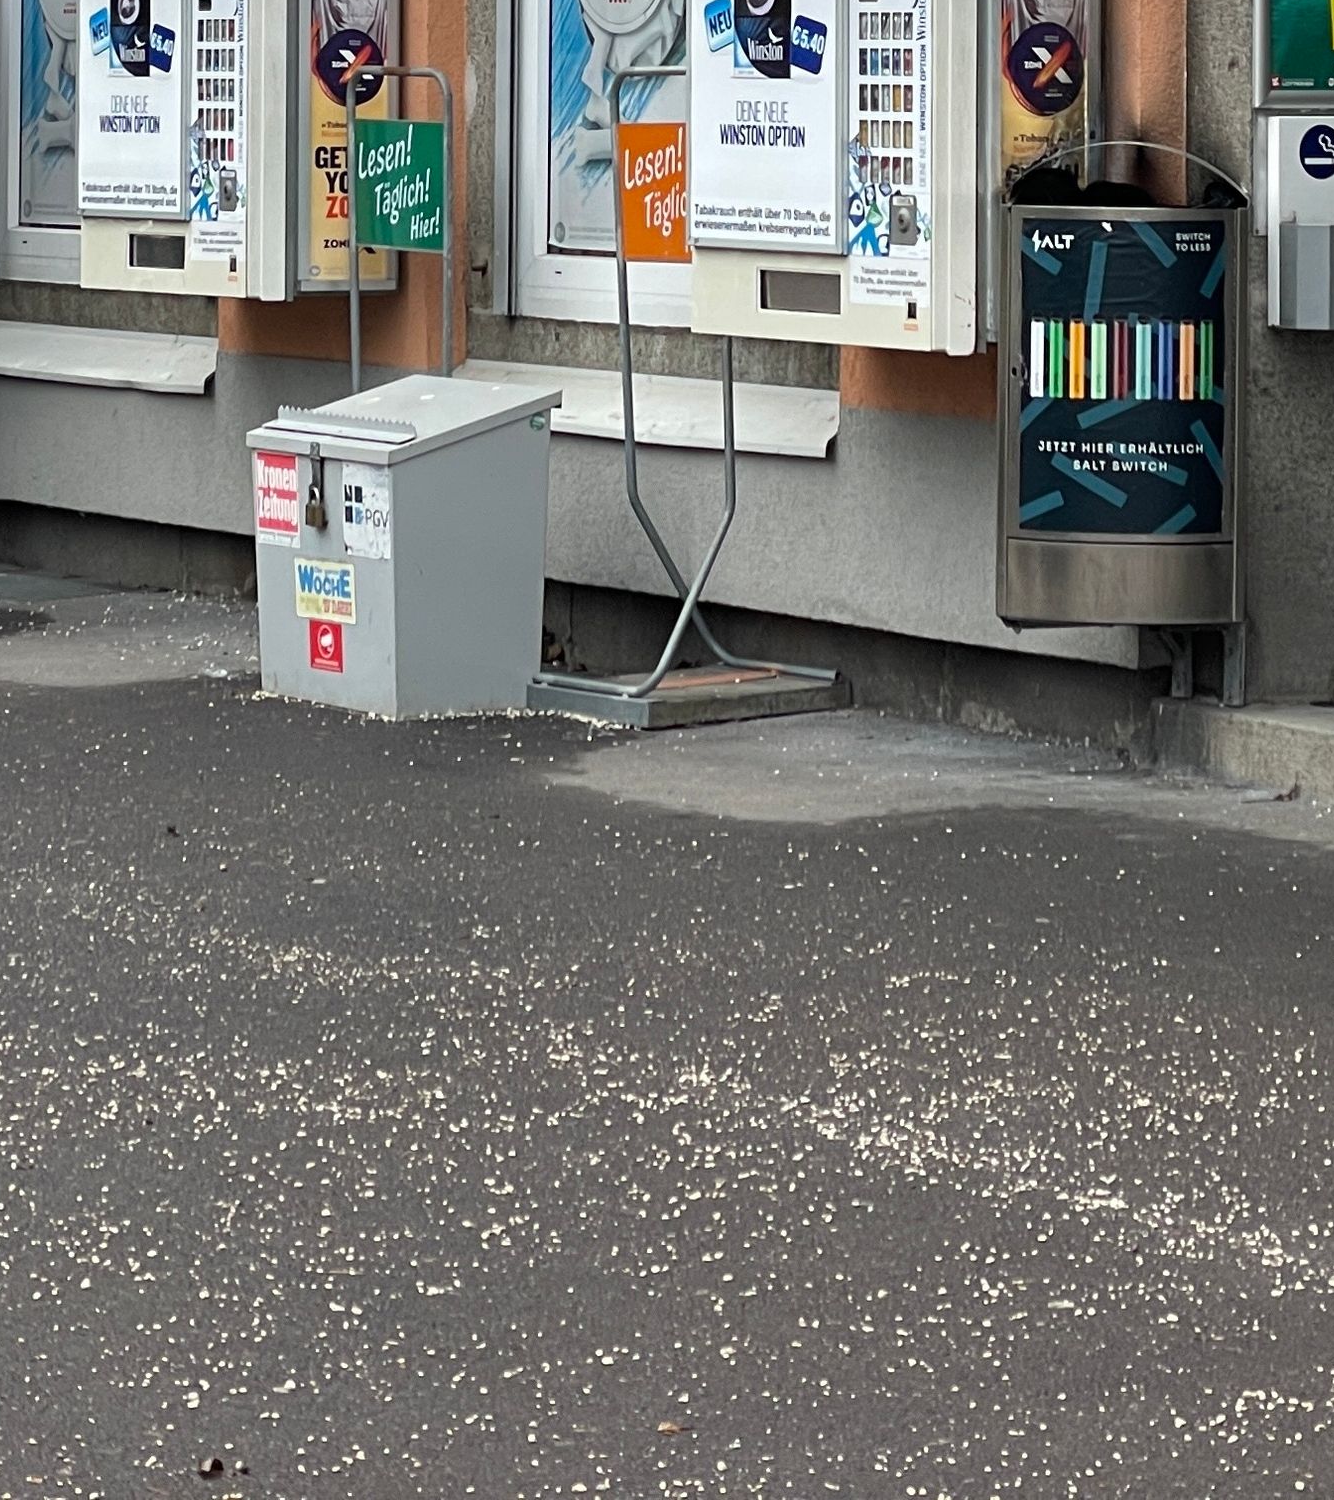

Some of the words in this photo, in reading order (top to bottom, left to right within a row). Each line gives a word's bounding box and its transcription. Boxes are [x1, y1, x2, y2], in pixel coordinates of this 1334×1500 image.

[91, 18, 108, 42] NEU
[708, 8, 732, 39] NEU
[747, 37, 784, 61] Winston
[792, 25, 825, 56] €5.40
[118, 42, 146, 64] Winston
[919, 44, 927, 82] OPTION
[735, 100, 762, 123] DEINE
[764, 101, 789, 123] NEUE
[919, 84, 927, 131] WINSTON
[99, 115, 132, 133] WINSTON
[134, 116, 161, 134] OPTION
[719, 124, 765, 147] WINSTON
[768, 125, 806, 148] OPTION
[358, 124, 413, 180] Lesen!
[623, 126, 684, 190] Lesen!
[375, 167, 431, 225] Täglich!
[410, 207, 440, 241] Hier!
[694, 203, 736, 217] Tabakrauch
[738, 206, 763, 218] enthält
[765, 207, 781, 219] über
[783, 208, 792, 220] 70
[793, 209, 818, 222] Stoffe,
[819, 210, 832, 222] die
[694, 220, 757, 232] erwiesenermaßen
[758, 221, 812, 237] krebserregend
[813, 225, 831, 237] sind.
[1175, 232, 1211, 242] SWITCH
[1175, 243, 1188, 252] TO
[1190, 243, 1211, 252] LESS
[1038, 440, 1075, 454] JETZT
[1081, 442, 1114, 454] HIER
[1120, 440, 1205, 455] ERHÄLTLICH
[257, 458, 298, 492] Kronen
[1072, 459, 1106, 472] SALT
[1112, 460, 1168, 473] SWITCH
[257, 489, 298, 526] Zeitung
[364, 508, 390, 528] PGV
